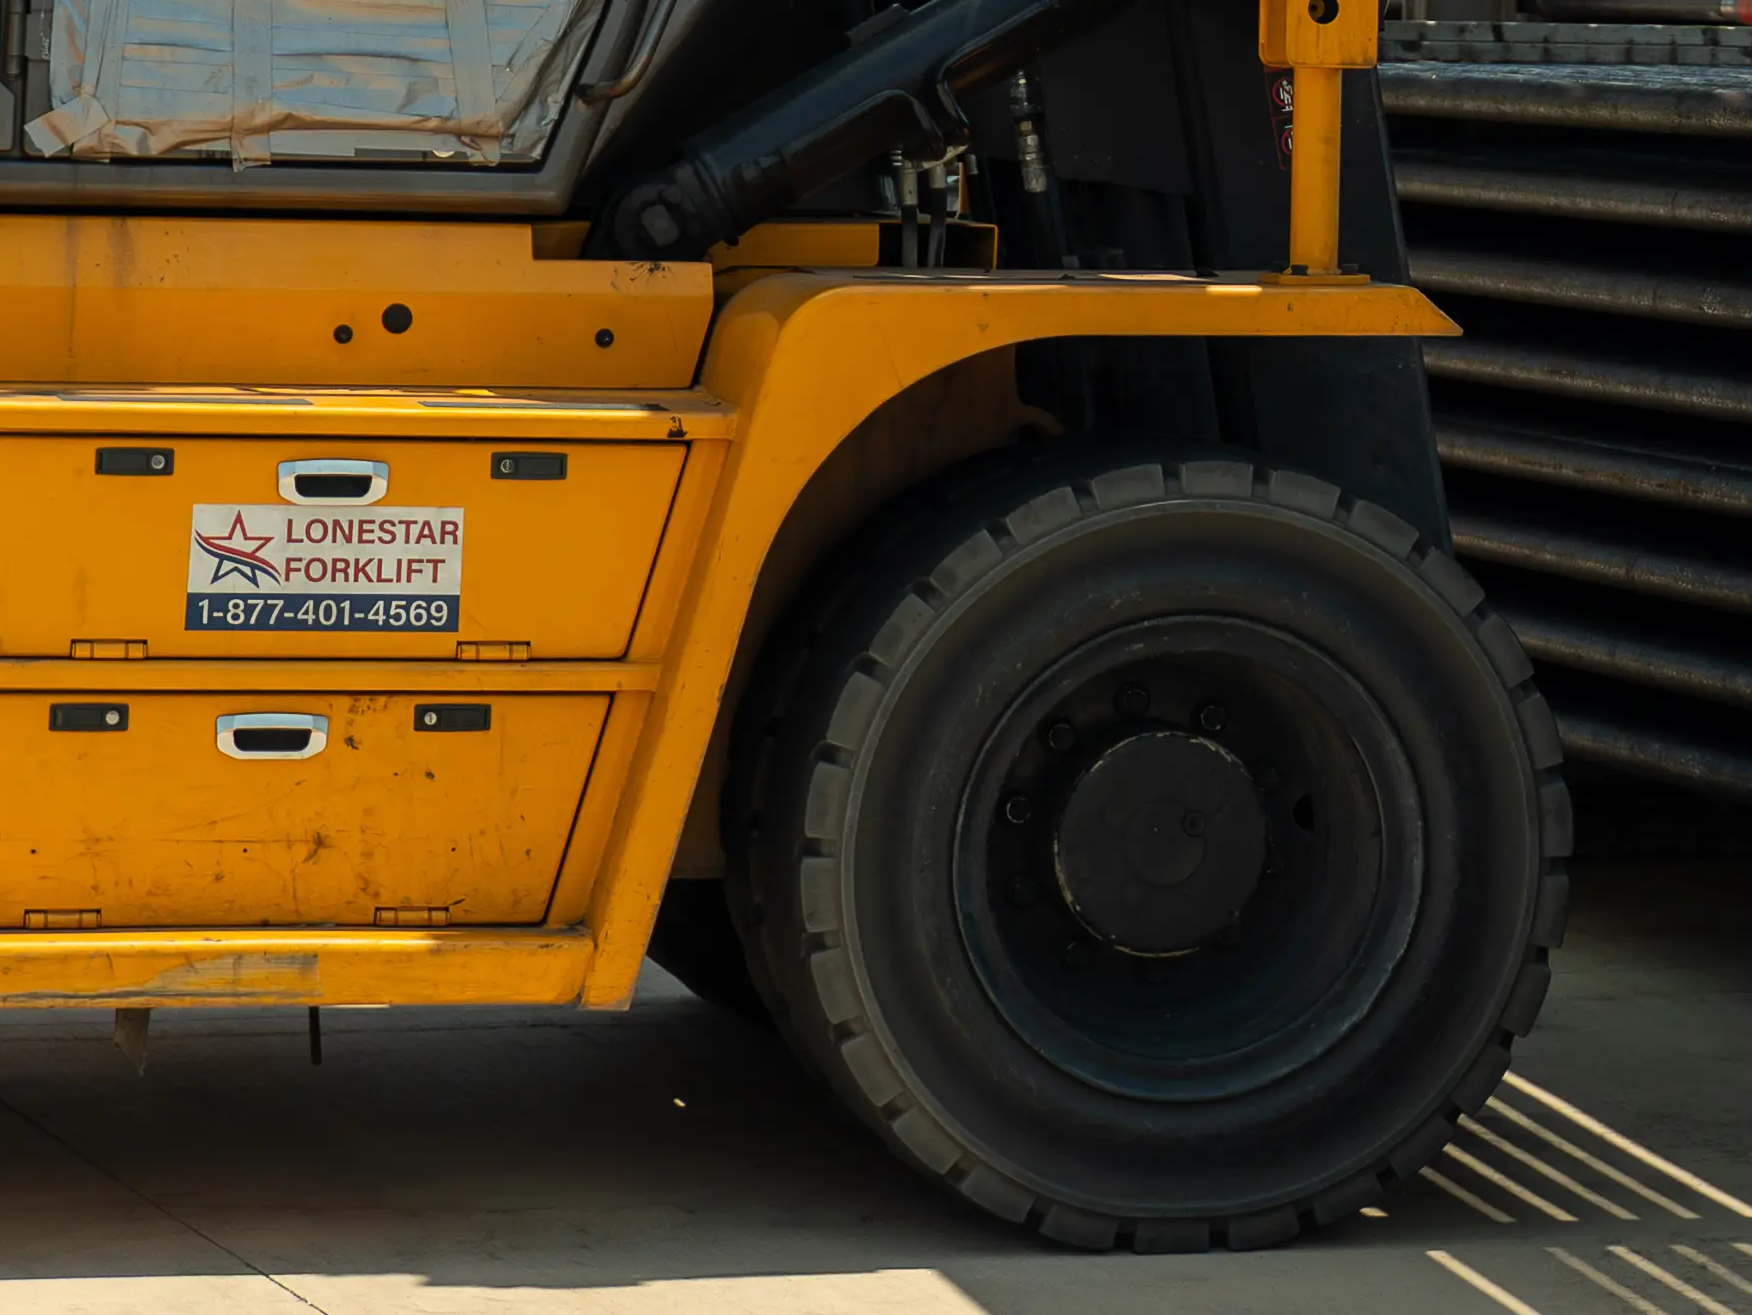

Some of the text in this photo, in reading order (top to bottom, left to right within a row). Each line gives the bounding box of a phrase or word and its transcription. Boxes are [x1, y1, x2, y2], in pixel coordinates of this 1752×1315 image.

[285, 518, 459, 545] LONESTAR
[283, 557, 446, 584] FORKLIFT
[198, 599, 449, 627] 1-877-401-4569
